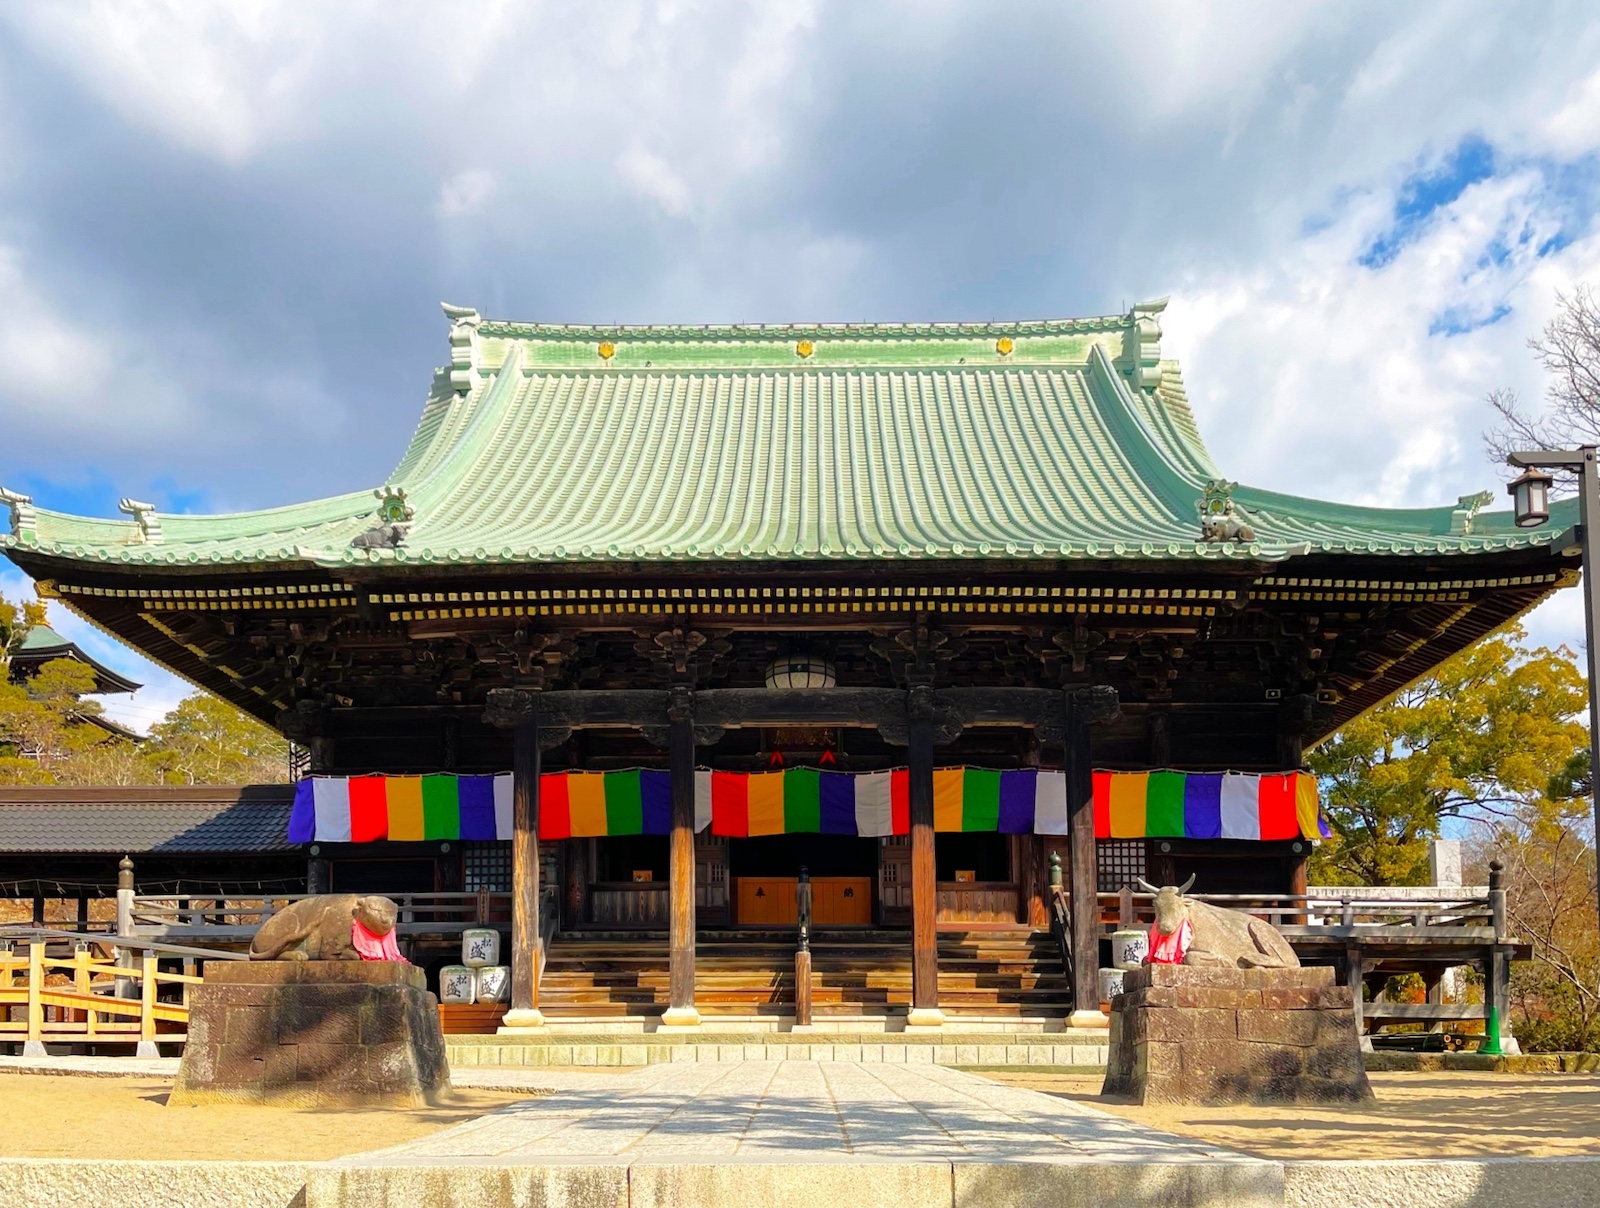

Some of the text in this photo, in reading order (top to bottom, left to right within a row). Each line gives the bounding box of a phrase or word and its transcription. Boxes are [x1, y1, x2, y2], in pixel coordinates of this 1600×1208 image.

[755, 886, 854, 899] 奉 納
[470, 937, 492, 960] 松盛
[1123, 939, 1144, 963] 松盛
[446, 974, 467, 997] 松盛
